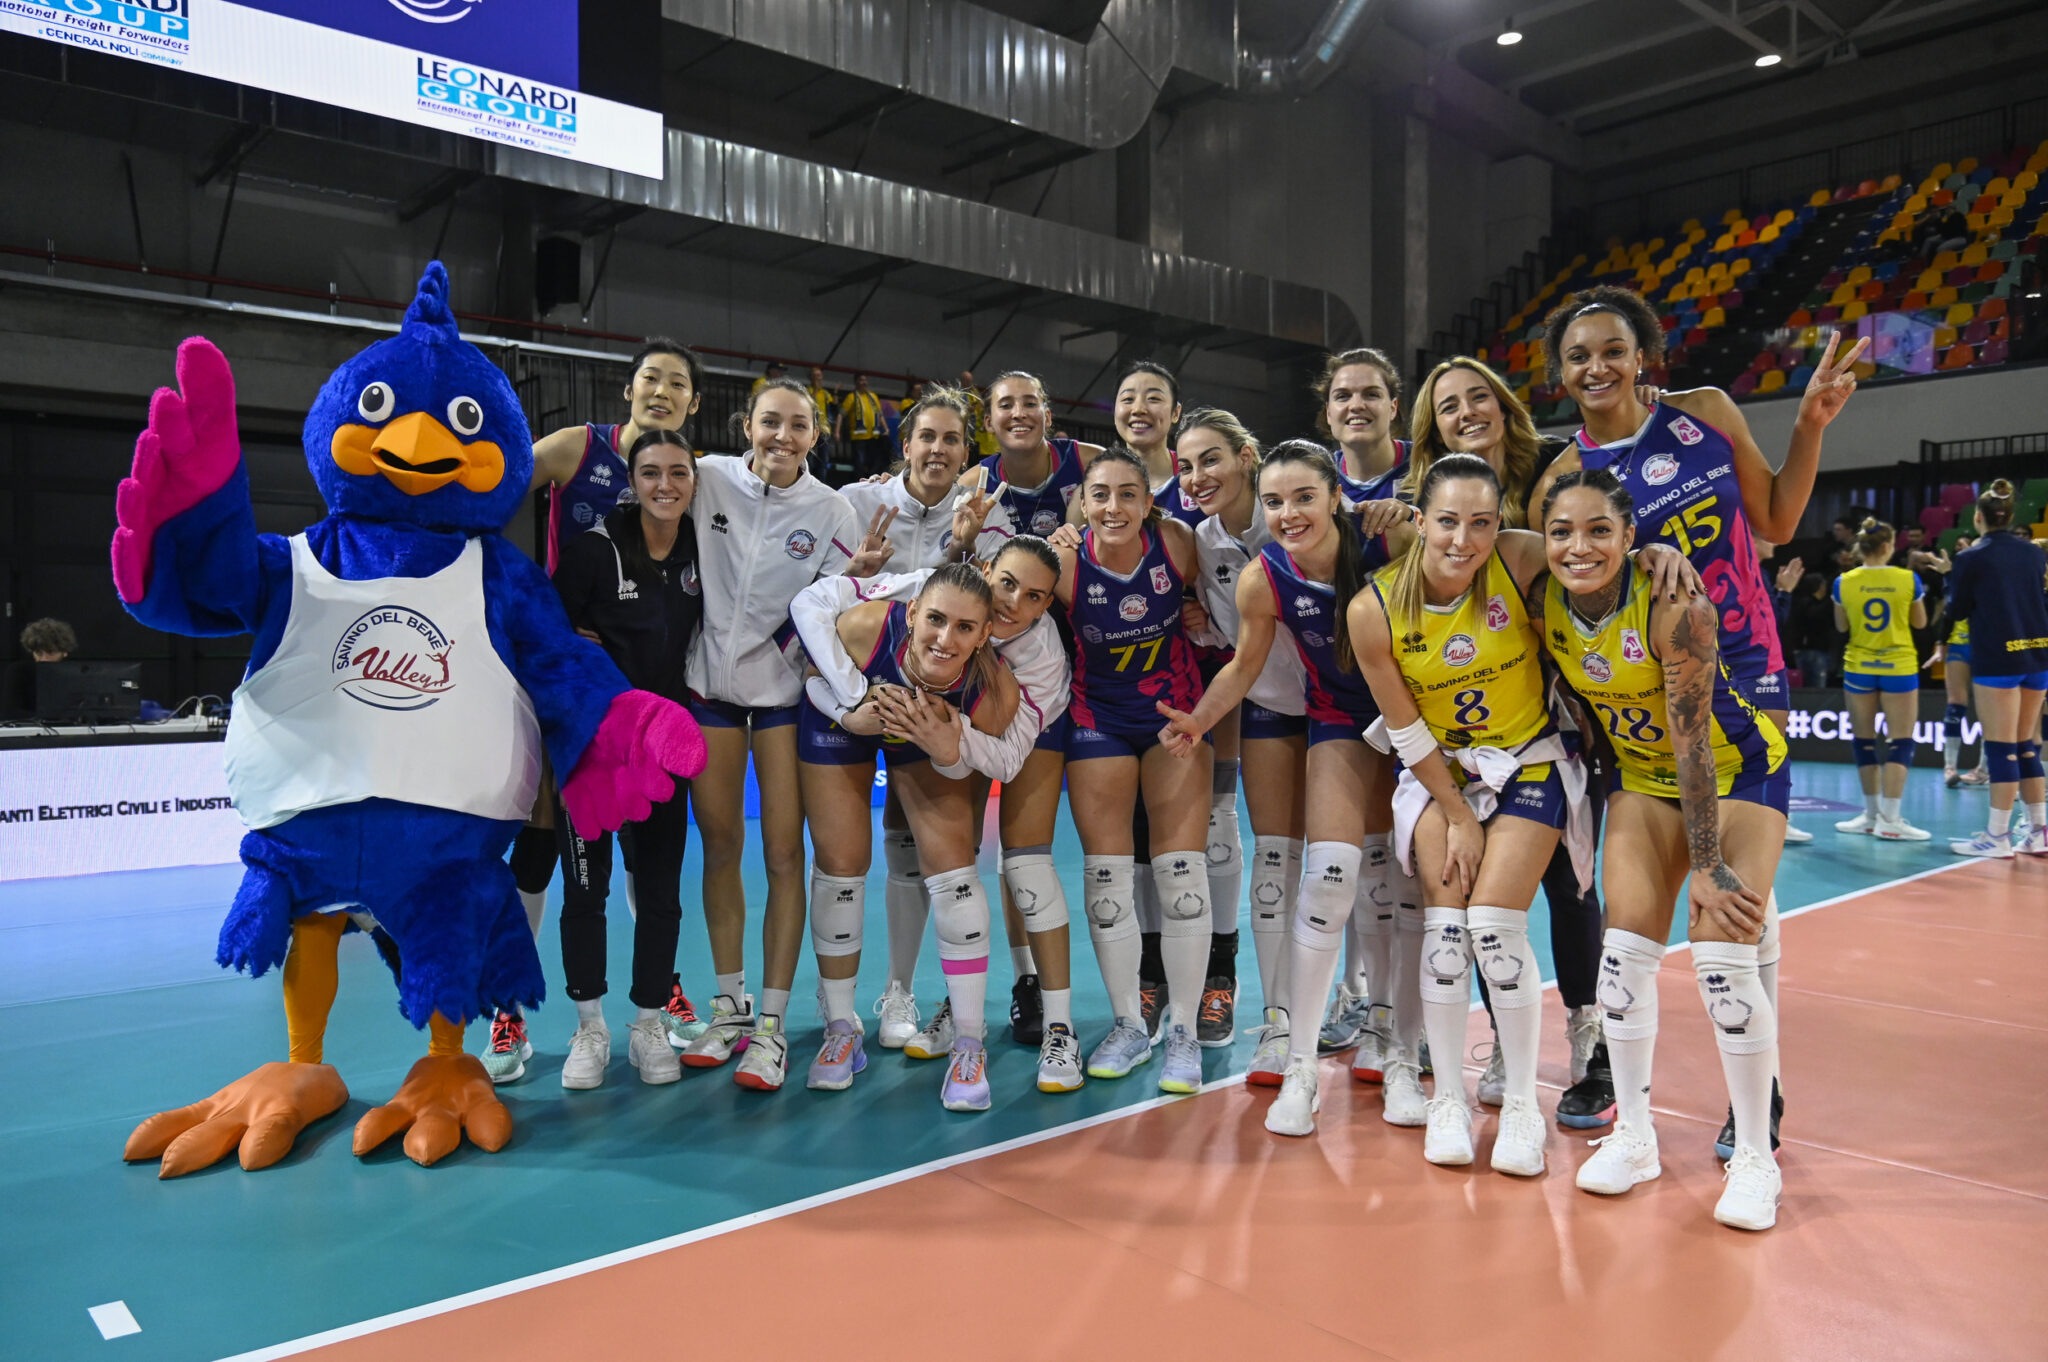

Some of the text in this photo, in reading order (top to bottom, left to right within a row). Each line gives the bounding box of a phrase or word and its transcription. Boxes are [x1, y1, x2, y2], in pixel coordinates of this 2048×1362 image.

[46, 28, 108, 49] GENERAL
[109, 42, 139, 56] NOLI
[64, 12, 112, 33] Freight
[119, 28, 190, 51] Forwarders
[417, 57, 576, 114] LEONARDI
[420, 81, 573, 129] GROUP
[417, 98, 577, 142] International Freight Forwarders
[590, 475, 611, 487] errea
[1637, 464, 1731, 518] SAVINO DEL BENE
[711, 523, 728, 535] errea
[1660, 495, 1722, 557] 15
[619, 591, 639, 600] errea
[1297, 606, 1320, 617] errea
[1863, 597, 1890, 633] 9
[337, 612, 443, 670] SAVINO DEL BENE
[1105, 628, 1140, 640] SAVINO
[1143, 624, 1162, 634] DEL
[1109, 636, 1166, 672] 77
[352, 647, 432, 689] Volley
[1427, 675, 1470, 691] SAVINO
[1473, 667, 1497, 679] DEL
[1500, 652, 1527, 671] BENE
[1612, 691, 1636, 700] DEL
[1755, 685, 1780, 694] errea
[1453, 689, 1490, 725] 8
[1594, 703, 1665, 742] 28
[826, 735, 848, 743] MSC
[1514, 797, 1543, 808] errea
[575, 837, 586, 856] DEL
[1323, 874, 1343, 883] errea
[956, 891, 972, 900] errea
[1441, 935, 1462, 943] errea
[1482, 942, 1502, 952] errea
